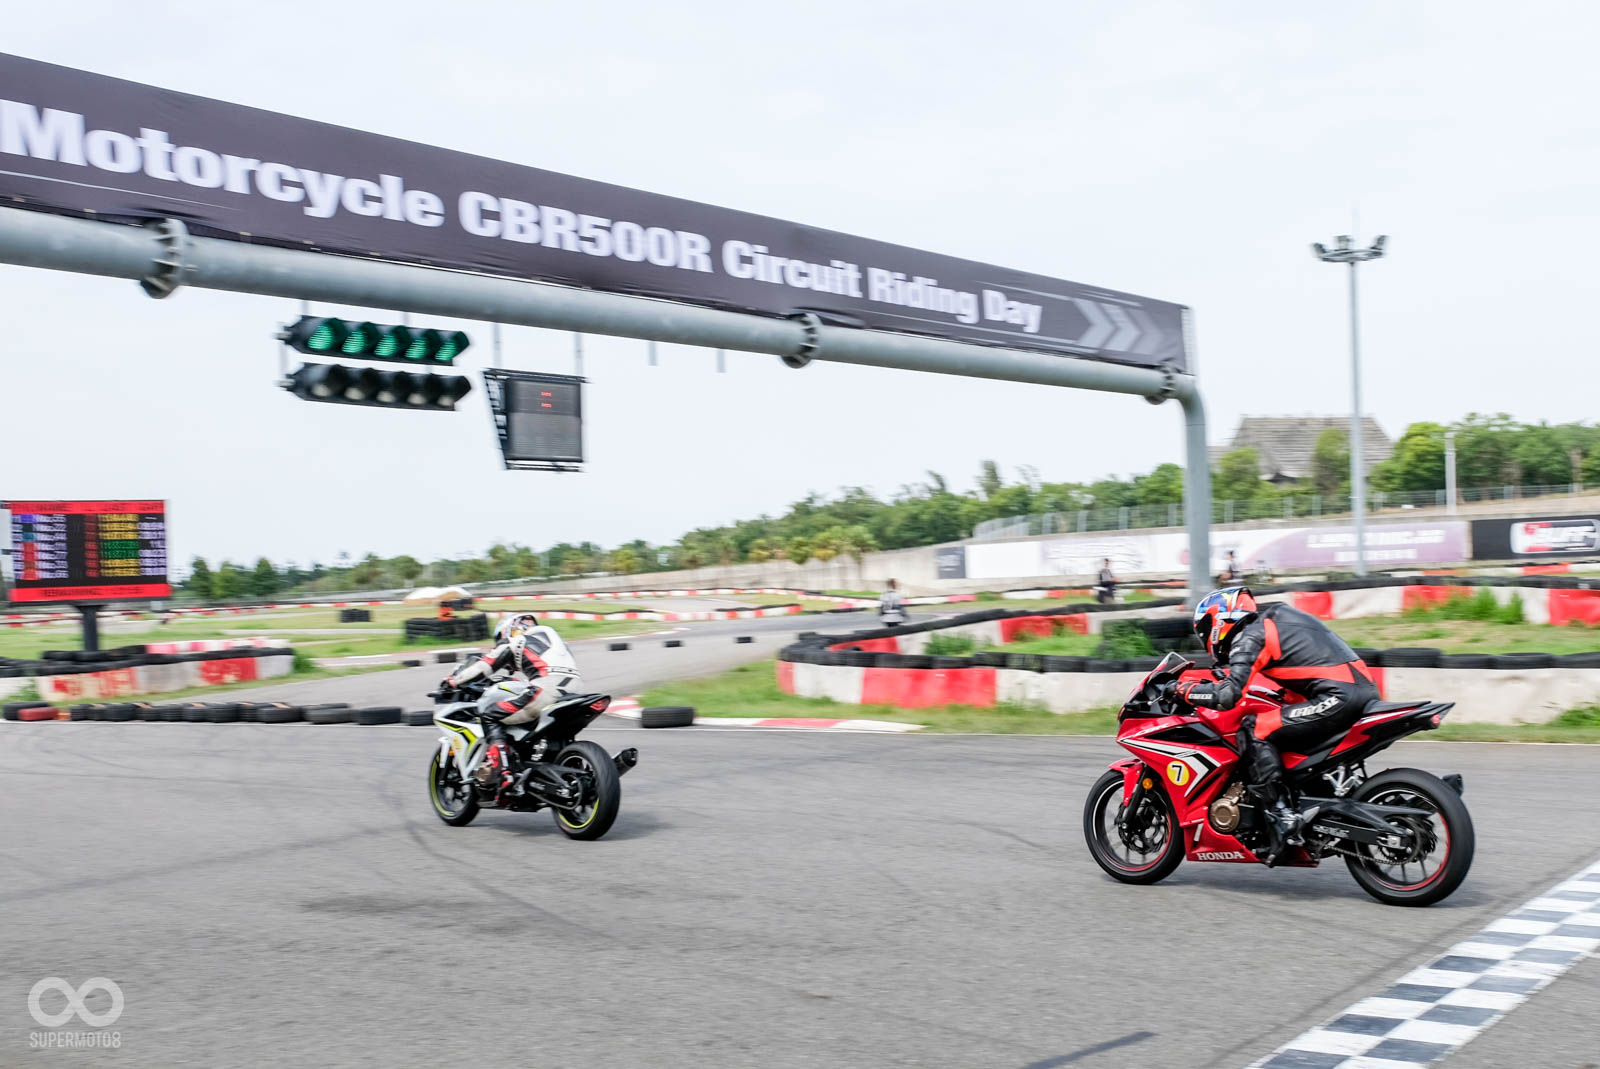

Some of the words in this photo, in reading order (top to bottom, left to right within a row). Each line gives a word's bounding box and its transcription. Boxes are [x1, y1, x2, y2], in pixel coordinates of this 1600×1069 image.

[0, 98, 445, 228] Motorcycle
[458, 191, 713, 274] CBR500R
[722, 239, 863, 298] Circuit
[867, 268, 980, 325] Riding
[982, 290, 1043, 334] Day
[1171, 764, 1183, 782] 7
[1196, 851, 1245, 861] HONDA
